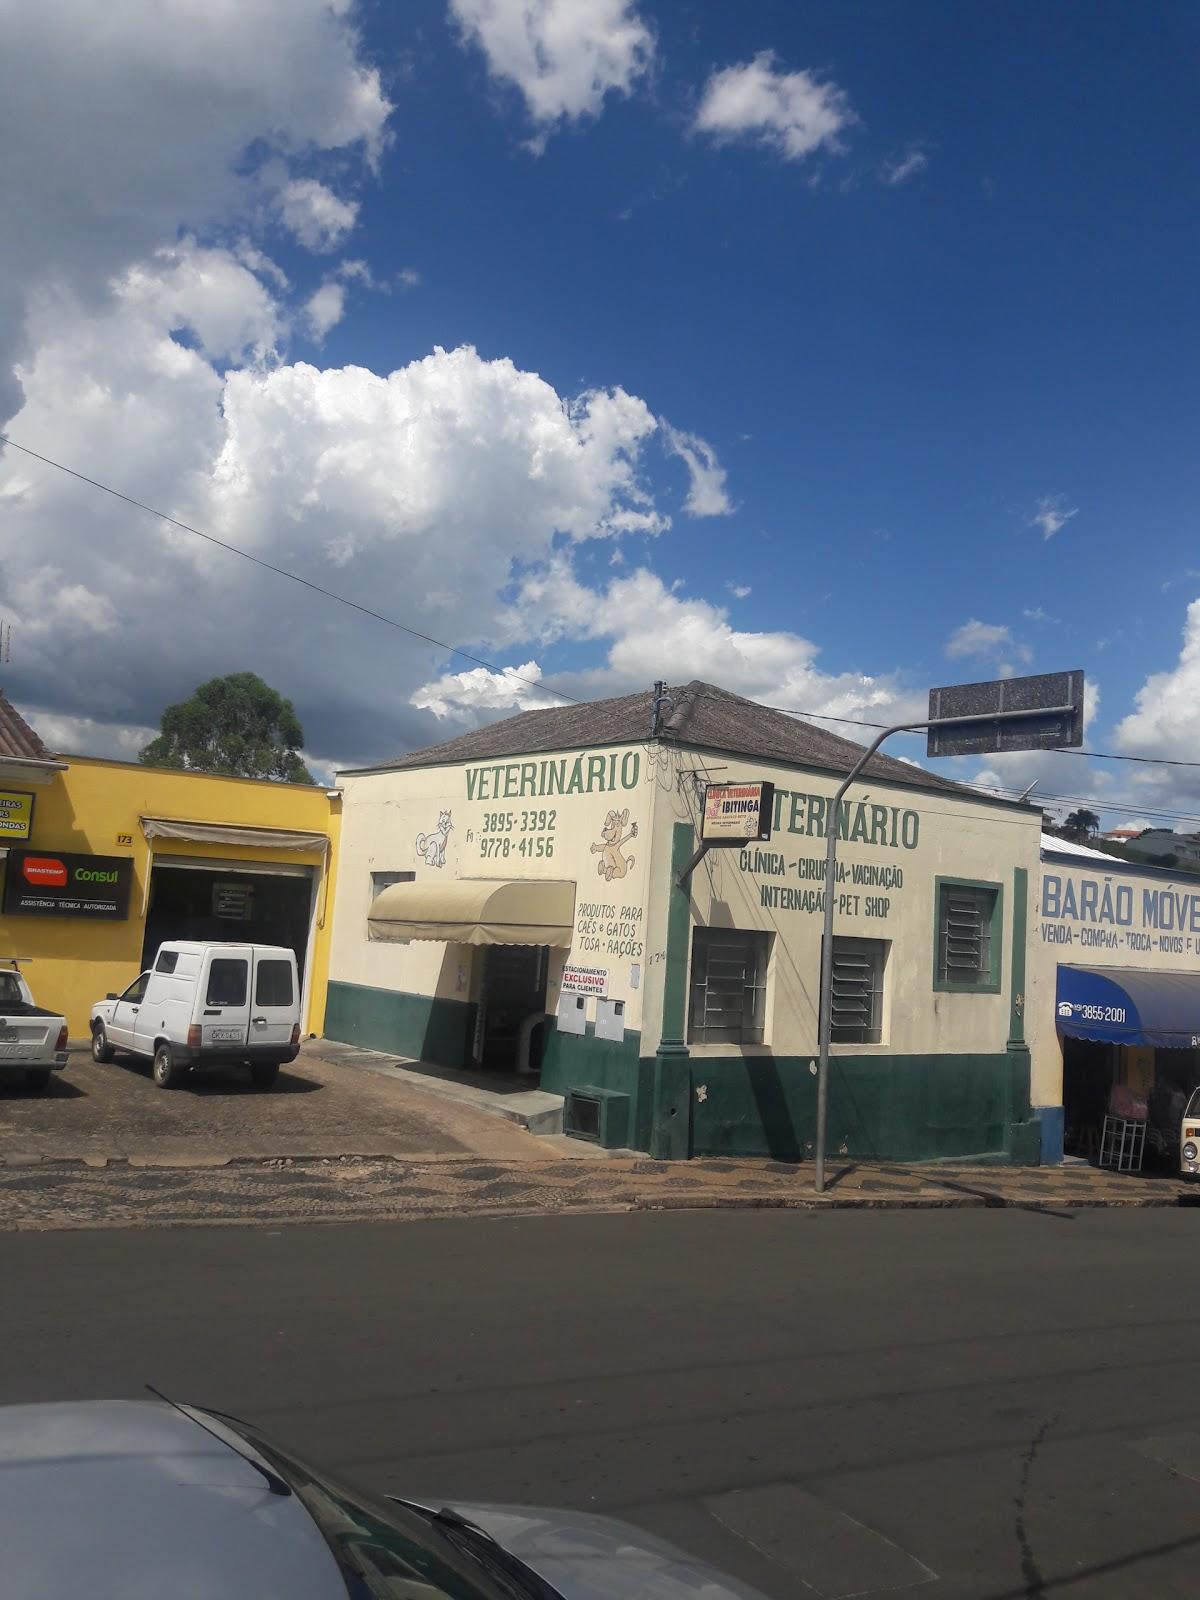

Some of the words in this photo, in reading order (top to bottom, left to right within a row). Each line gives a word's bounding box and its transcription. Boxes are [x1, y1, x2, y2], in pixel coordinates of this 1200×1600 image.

[465, 752, 640, 800] VETERINÁRIO
[722, 800, 759, 813] IBITINGA
[773, 789, 920, 850] TERINÁRIO
[117, 835, 133, 844] 173
[75, 868, 119, 883] Consul
[740, 848, 785, 876] CLÍNICA
[798, 857, 846, 883] CIRURIA
[852, 864, 904, 891] VACINAÇÃO
[840, 894, 861, 916] PET
[865, 896, 890, 918] SHOP
[1041, 876, 1134, 926] BARÃO
[577, 903, 616, 919] PRODUTOS
[620, 906, 643, 921] PARA
[606, 922, 636, 938] GATOS
[1041, 923, 1073, 945] VENDA
[1080, 928, 1119, 949] COMPRA
[1126, 932, 1152, 952] TROCA
[1159, 935, 1184, 954] NOVOS
[580, 936, 600, 951] TOSA
[606, 938, 643, 959] RAÇÕES
[563, 965, 607, 977] ESTACIONAMENTO
[564, 973, 605, 986] EXCLUSIVO
[563, 982, 576, 990] PARA
[577, 984, 603, 994] CLIENTES
